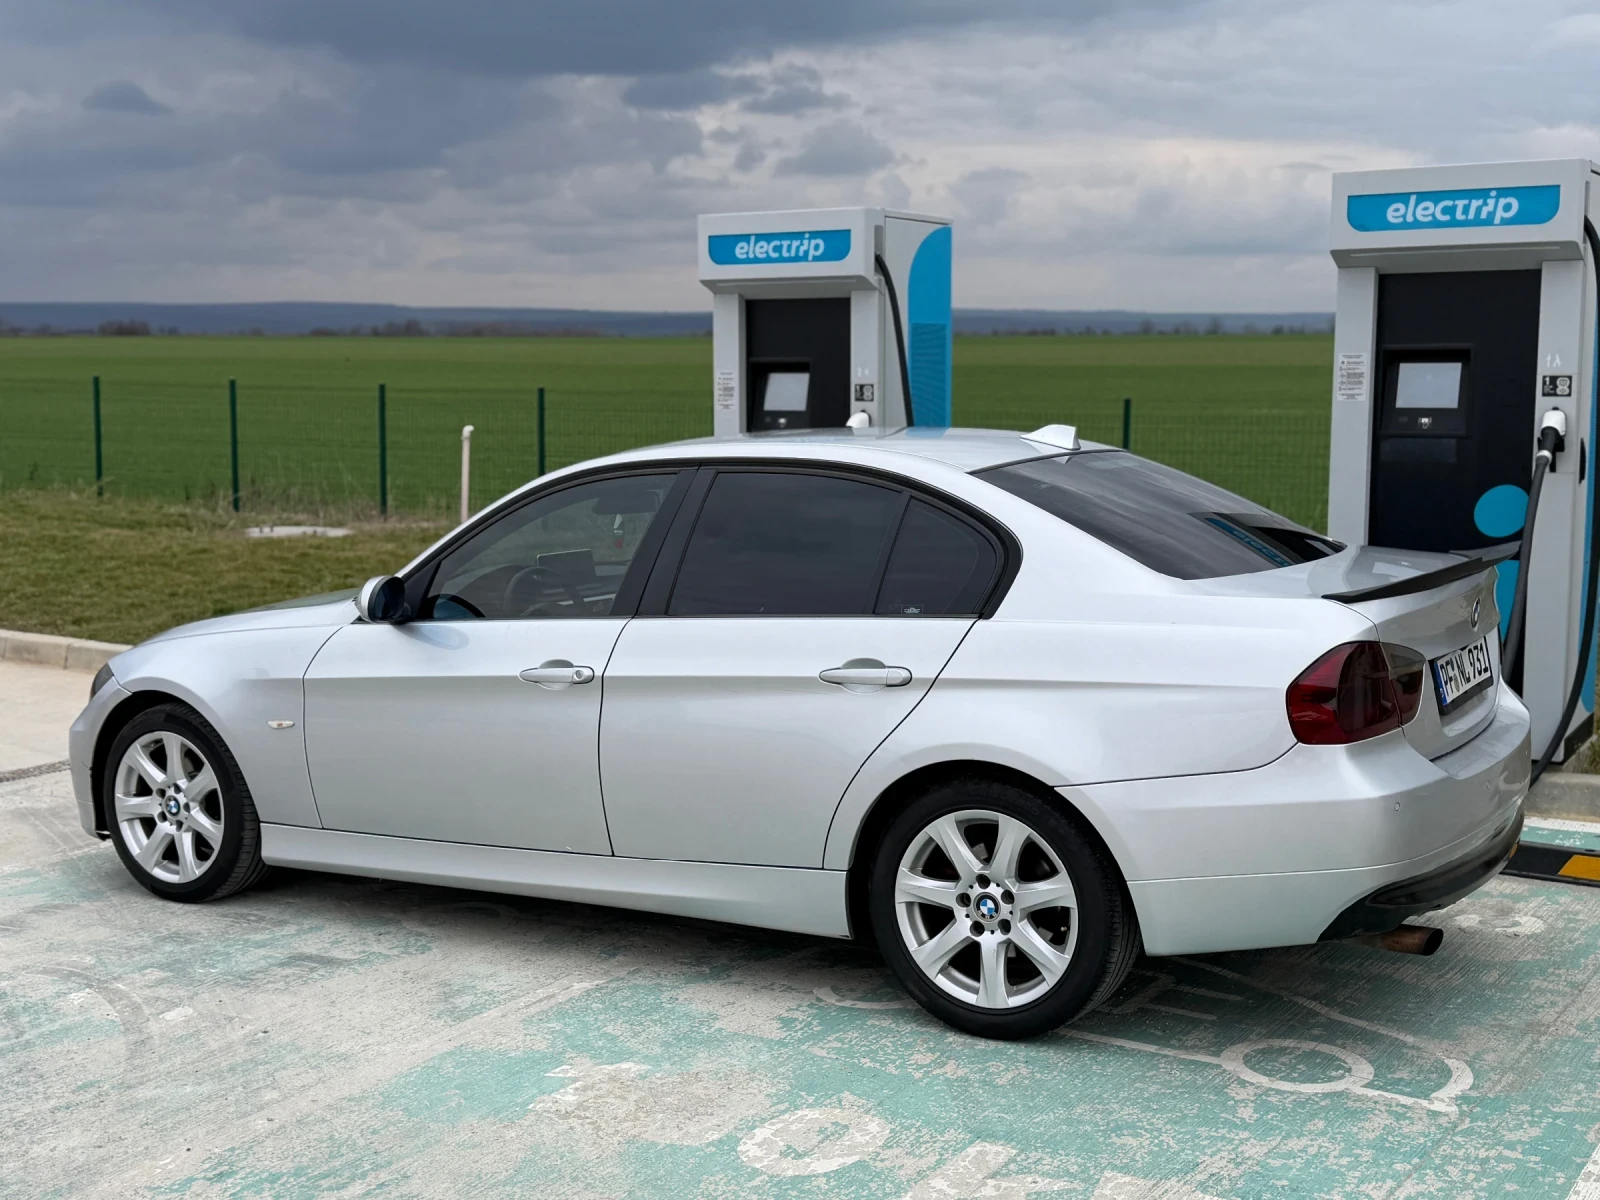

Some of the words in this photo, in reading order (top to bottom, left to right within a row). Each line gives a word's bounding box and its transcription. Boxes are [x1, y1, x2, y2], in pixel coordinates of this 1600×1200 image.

[1386, 189, 1519, 225] electrip
[735, 232, 825, 261] electrip
[1440, 660, 1454, 697] PF
[1455, 653, 1471, 687] NL
[1468, 643, 1489, 680] 931
